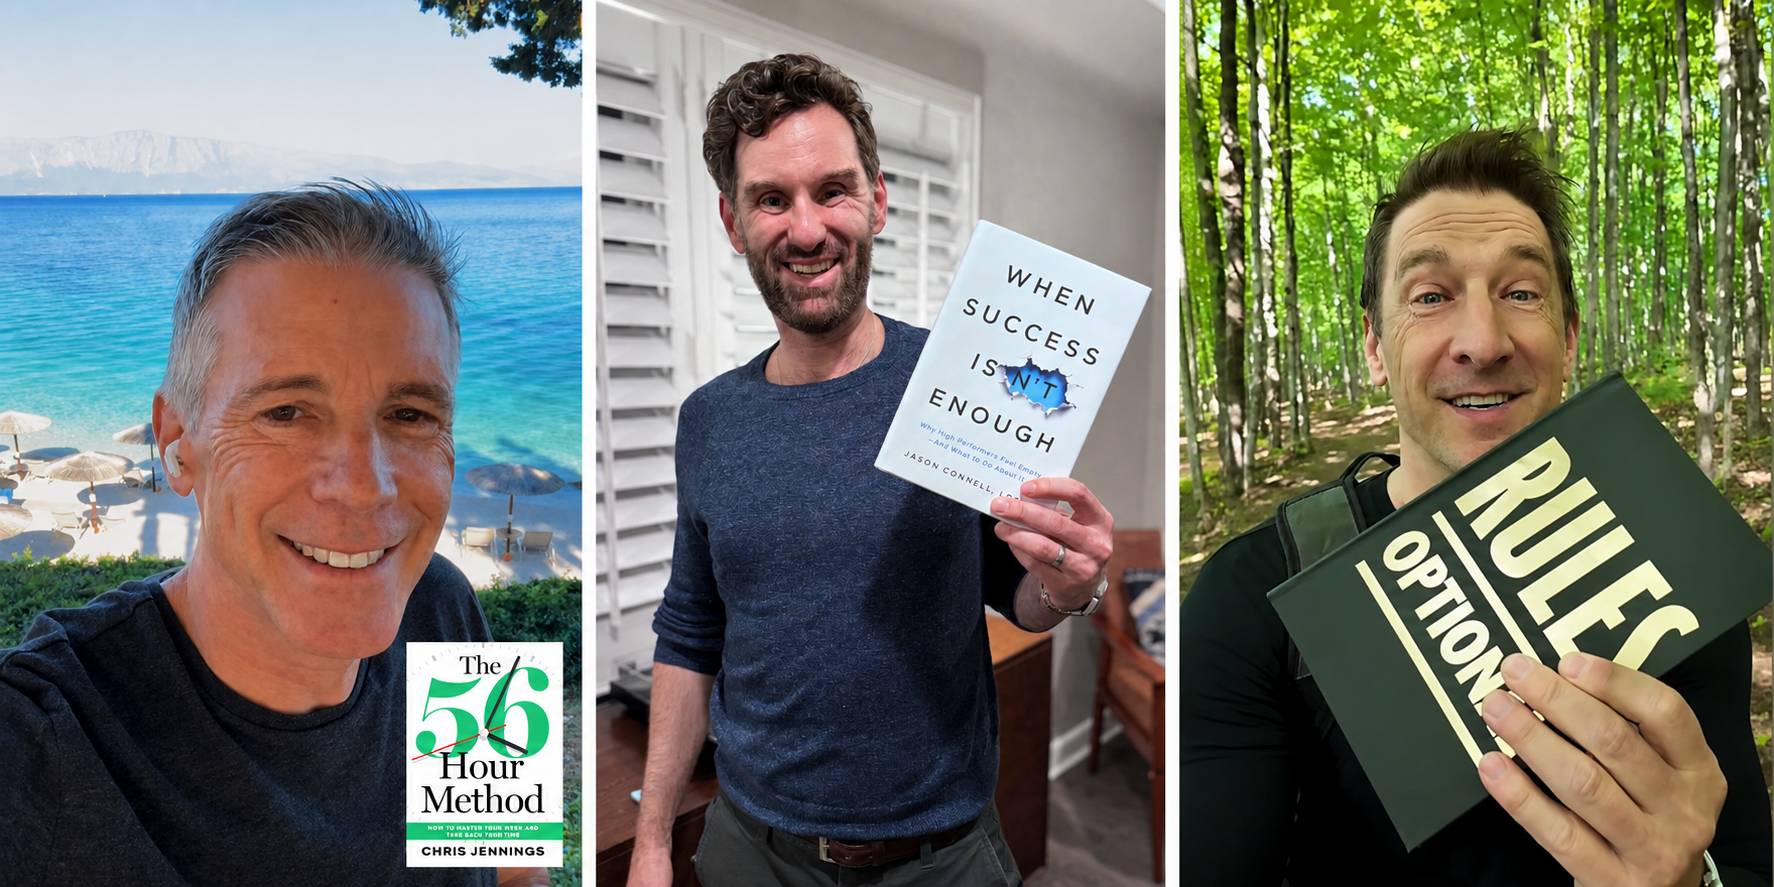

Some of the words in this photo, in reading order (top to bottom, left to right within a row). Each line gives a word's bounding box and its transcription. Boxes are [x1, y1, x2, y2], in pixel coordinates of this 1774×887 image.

[1007, 265, 1095, 315] WHEN
[963, 298, 1100, 365] SUCCESS
[970, 353, 1058, 399] ISN'T
[929, 388, 1055, 453] ENOUGH
[904, 450, 939, 469] JASON
[942, 467, 994, 495] CONNELL,
[920, 422, 936, 434] Why
[938, 427, 956, 441] High
[957, 435, 998, 460] Performers
[1018, 463, 1042, 479] Empty
[951, 446, 970, 459] What
[972, 455, 981, 464] to
[982, 460, 993, 468] Do
[995, 465, 1017, 479] About
[1382, 530, 1546, 760] OPTION
